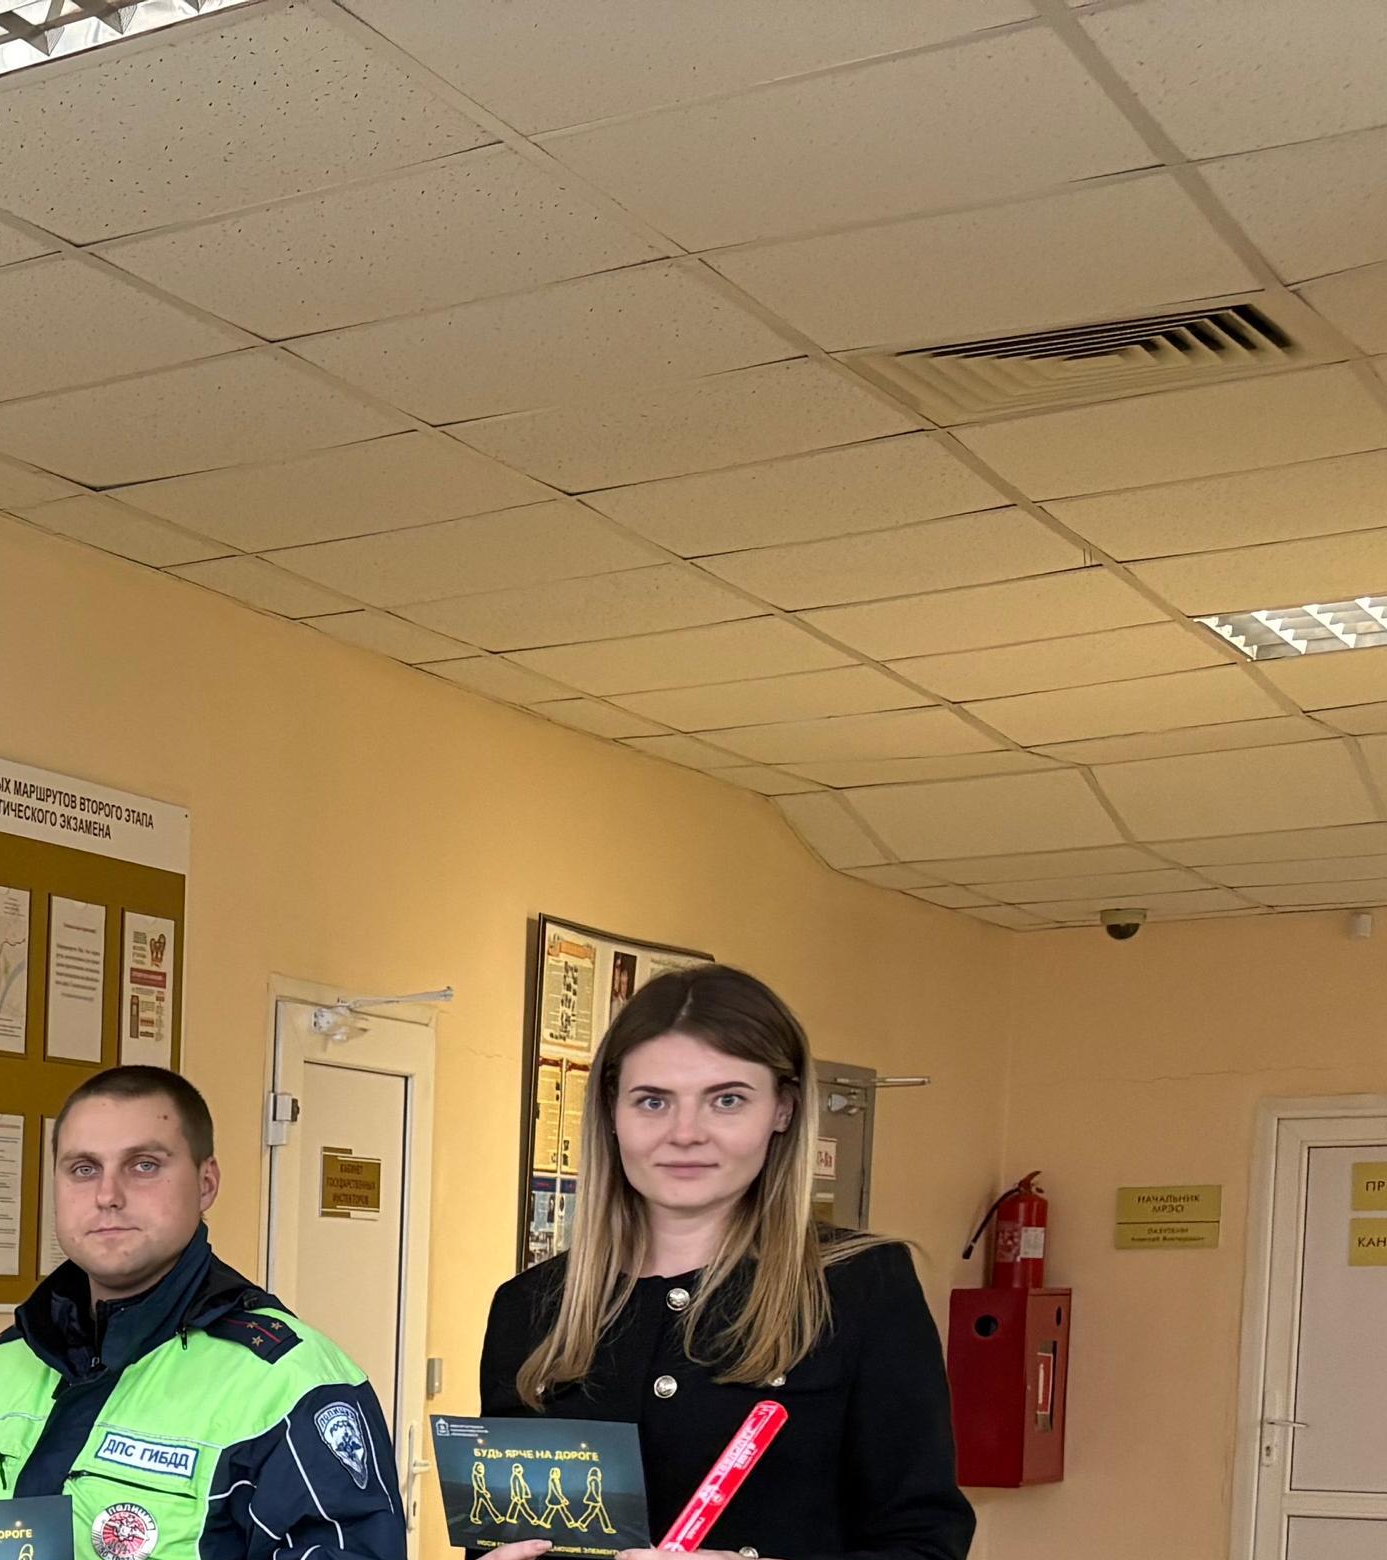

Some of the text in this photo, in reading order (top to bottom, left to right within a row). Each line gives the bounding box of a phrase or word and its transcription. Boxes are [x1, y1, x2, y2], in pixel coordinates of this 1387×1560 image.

[13, 779, 78, 810] МАРШРУТОВ
[79, 794, 124, 822] ВТОРОГО
[124, 806, 156, 830] ЭТАПА
[59, 813, 113, 841] ЭКЗАМЕНА
[1137, 1193, 1201, 1205] НАЧАЛЬНИК
[103, 1438, 190, 1471] ДПС ГИБДД
[473, 1447, 600, 1462] БУДЬ ЯРЧЕ НА ДОРОГЕ
[108, 1502, 156, 1531] ПОЛИЦИЯ
